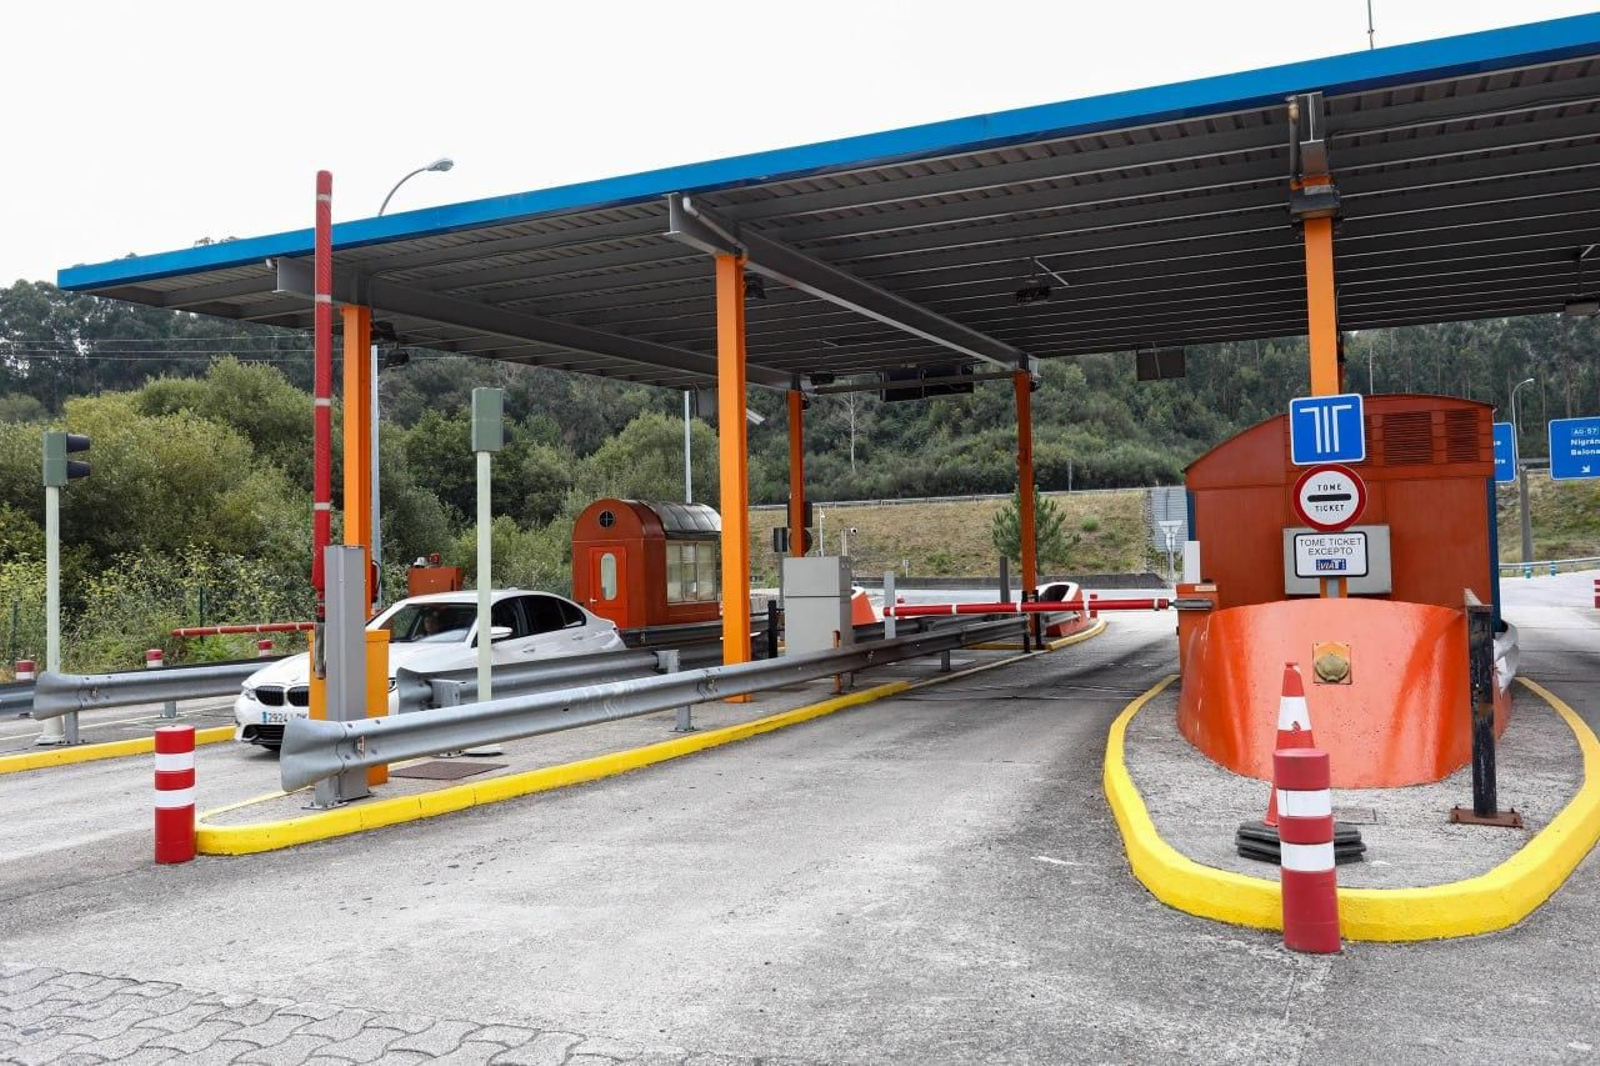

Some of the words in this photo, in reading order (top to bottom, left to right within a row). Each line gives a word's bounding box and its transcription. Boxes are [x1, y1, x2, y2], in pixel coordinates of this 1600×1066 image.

[1315, 504, 1345, 512] TICKET
[1300, 538, 1326, 547] TOME
[1329, 537, 1362, 546] TICKET
[1308, 547, 1353, 556] EXCEPTO
